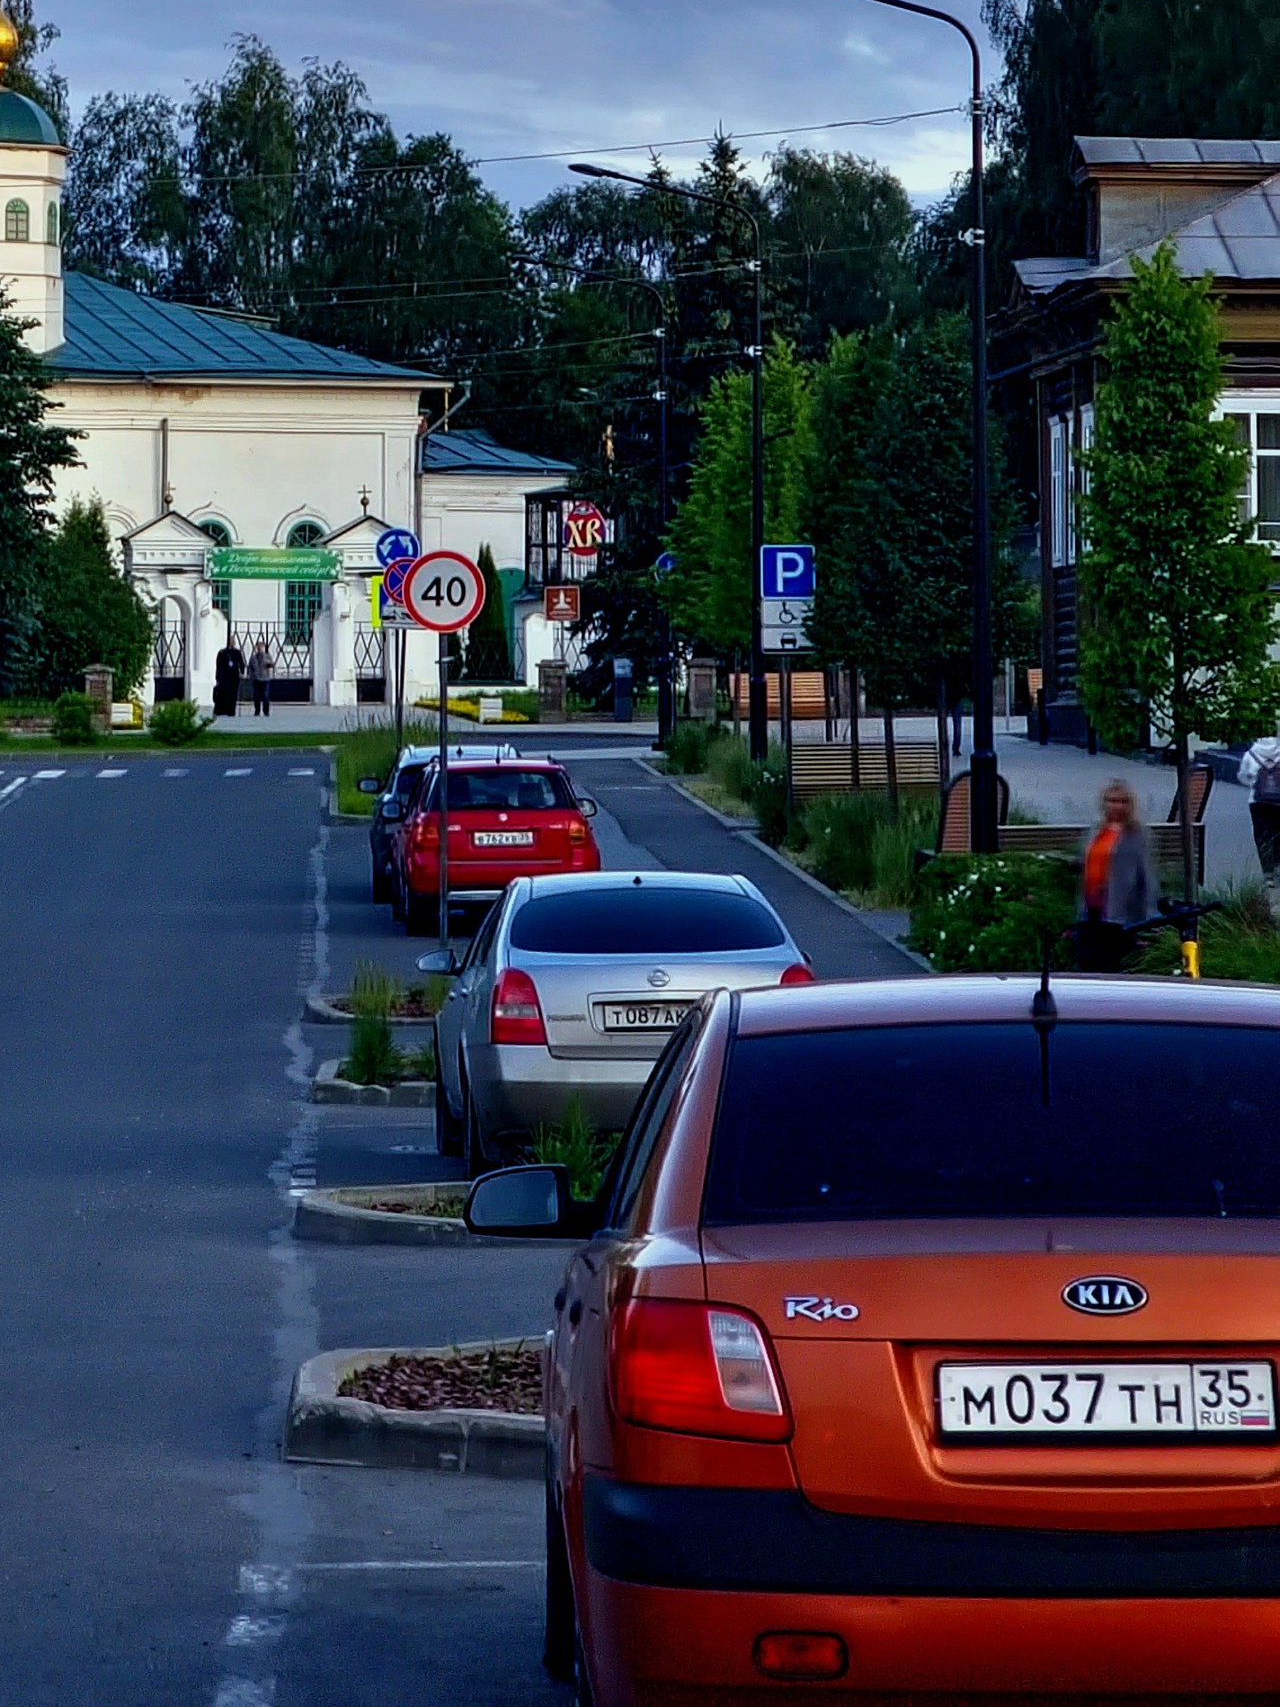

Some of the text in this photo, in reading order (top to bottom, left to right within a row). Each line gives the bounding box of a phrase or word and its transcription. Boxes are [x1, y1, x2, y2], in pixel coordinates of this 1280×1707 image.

[777, 552, 805, 593] P
[421, 576, 466, 607] 40
[1078, 1284, 1135, 1305] KIA
[784, 1297, 859, 1321] Rio
[1199, 1370, 1251, 1409] 35
[1200, 1411, 1239, 1425] RUS
